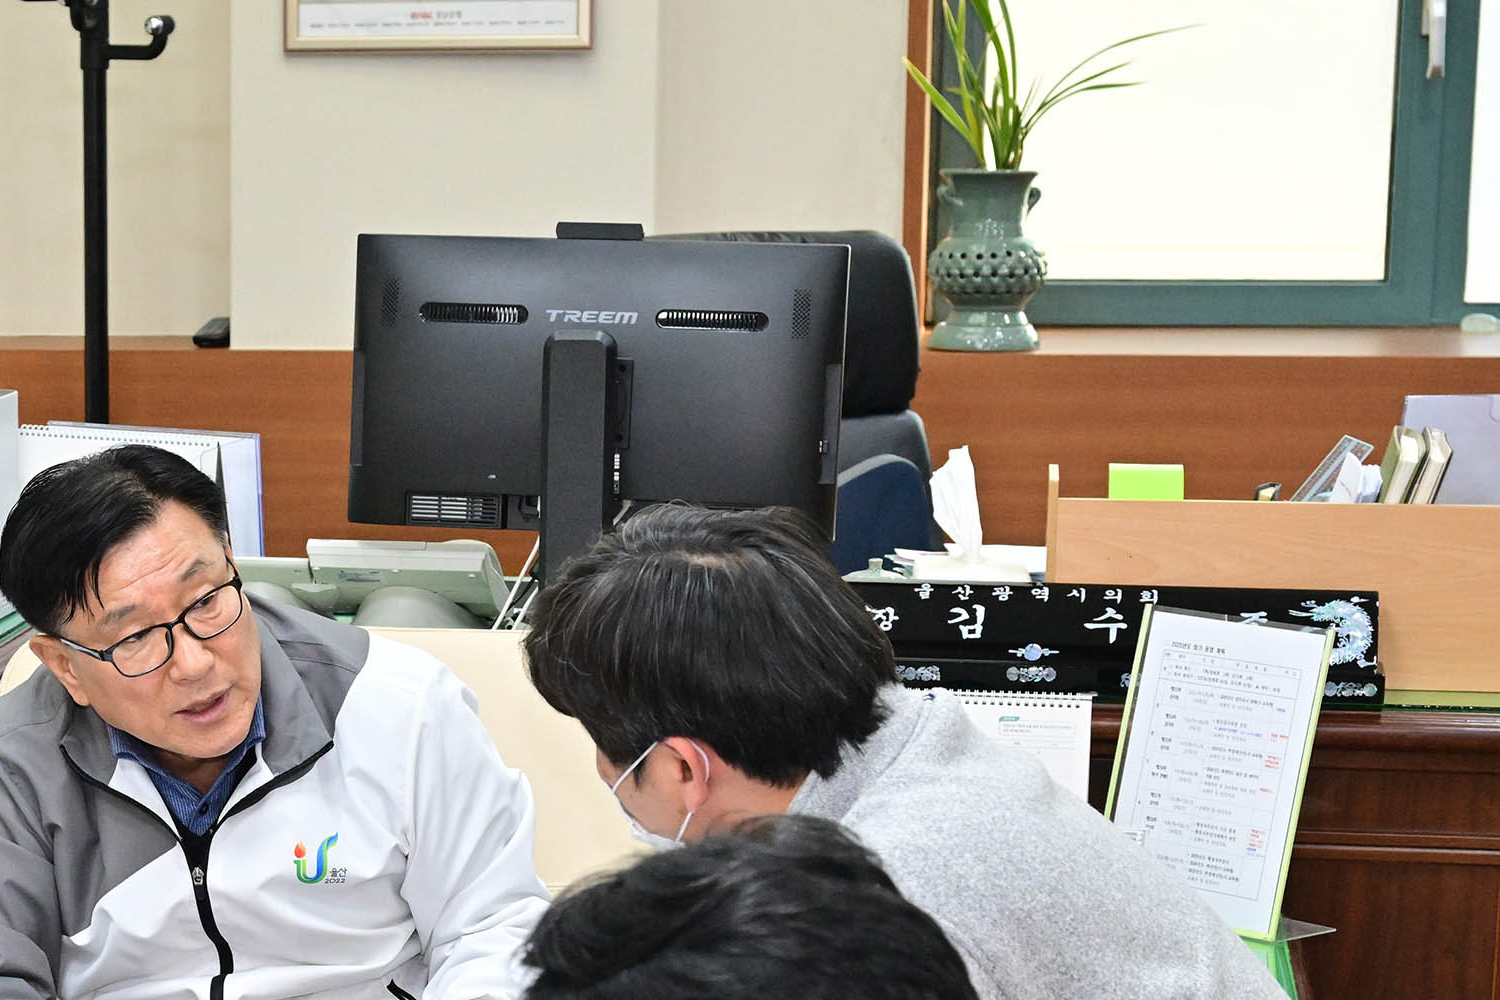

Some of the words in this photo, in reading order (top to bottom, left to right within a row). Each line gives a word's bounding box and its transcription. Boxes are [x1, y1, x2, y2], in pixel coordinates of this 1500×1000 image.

[546, 309, 638, 325] TREEM
[914, 583, 1159, 605] 울산광역시의회
[947, 604, 986, 639] 김
[1083, 607, 1128, 644] 수
[329, 867, 348, 878] 울산
